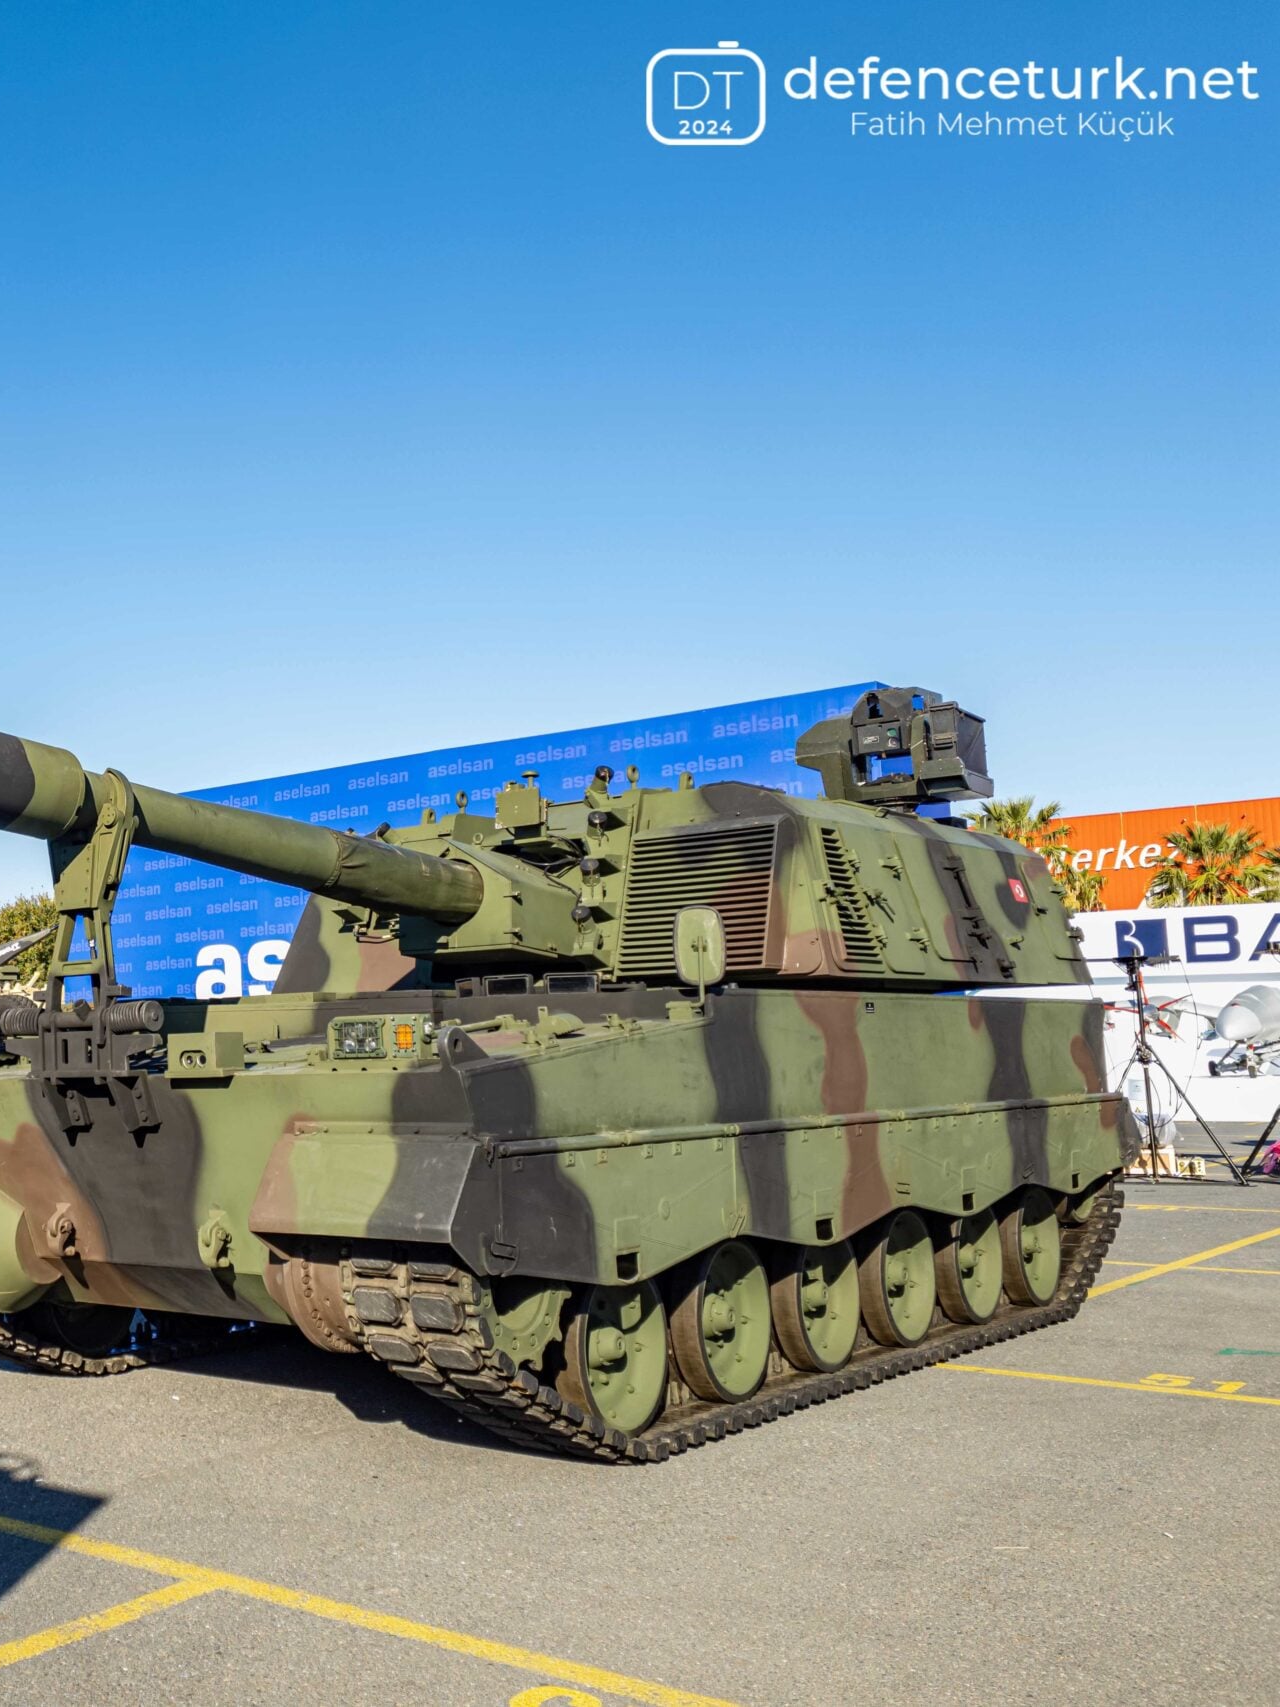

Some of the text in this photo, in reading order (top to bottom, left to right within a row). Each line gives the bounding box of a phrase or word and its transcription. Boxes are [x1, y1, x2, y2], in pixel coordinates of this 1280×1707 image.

[273, 783, 331, 802] aselsan
[347, 770, 409, 791] aselsan
[427, 757, 494, 779] aselsan
[514, 744, 587, 767] aselsan
[609, 727, 689, 752] aselsan
[713, 711, 799, 739] aselsan
[309, 803, 369, 823] aselsan
[386, 791, 451, 813] aselsan
[174, 875, 224, 893] aselsan
[144, 905, 192, 921] aselsan
[206, 898, 259, 915] aselsan
[116, 933, 162, 949] aselsan
[175, 926, 225, 944] aselsan
[240, 921, 295, 938] aselsan
[145, 955, 193, 971] aselsan
